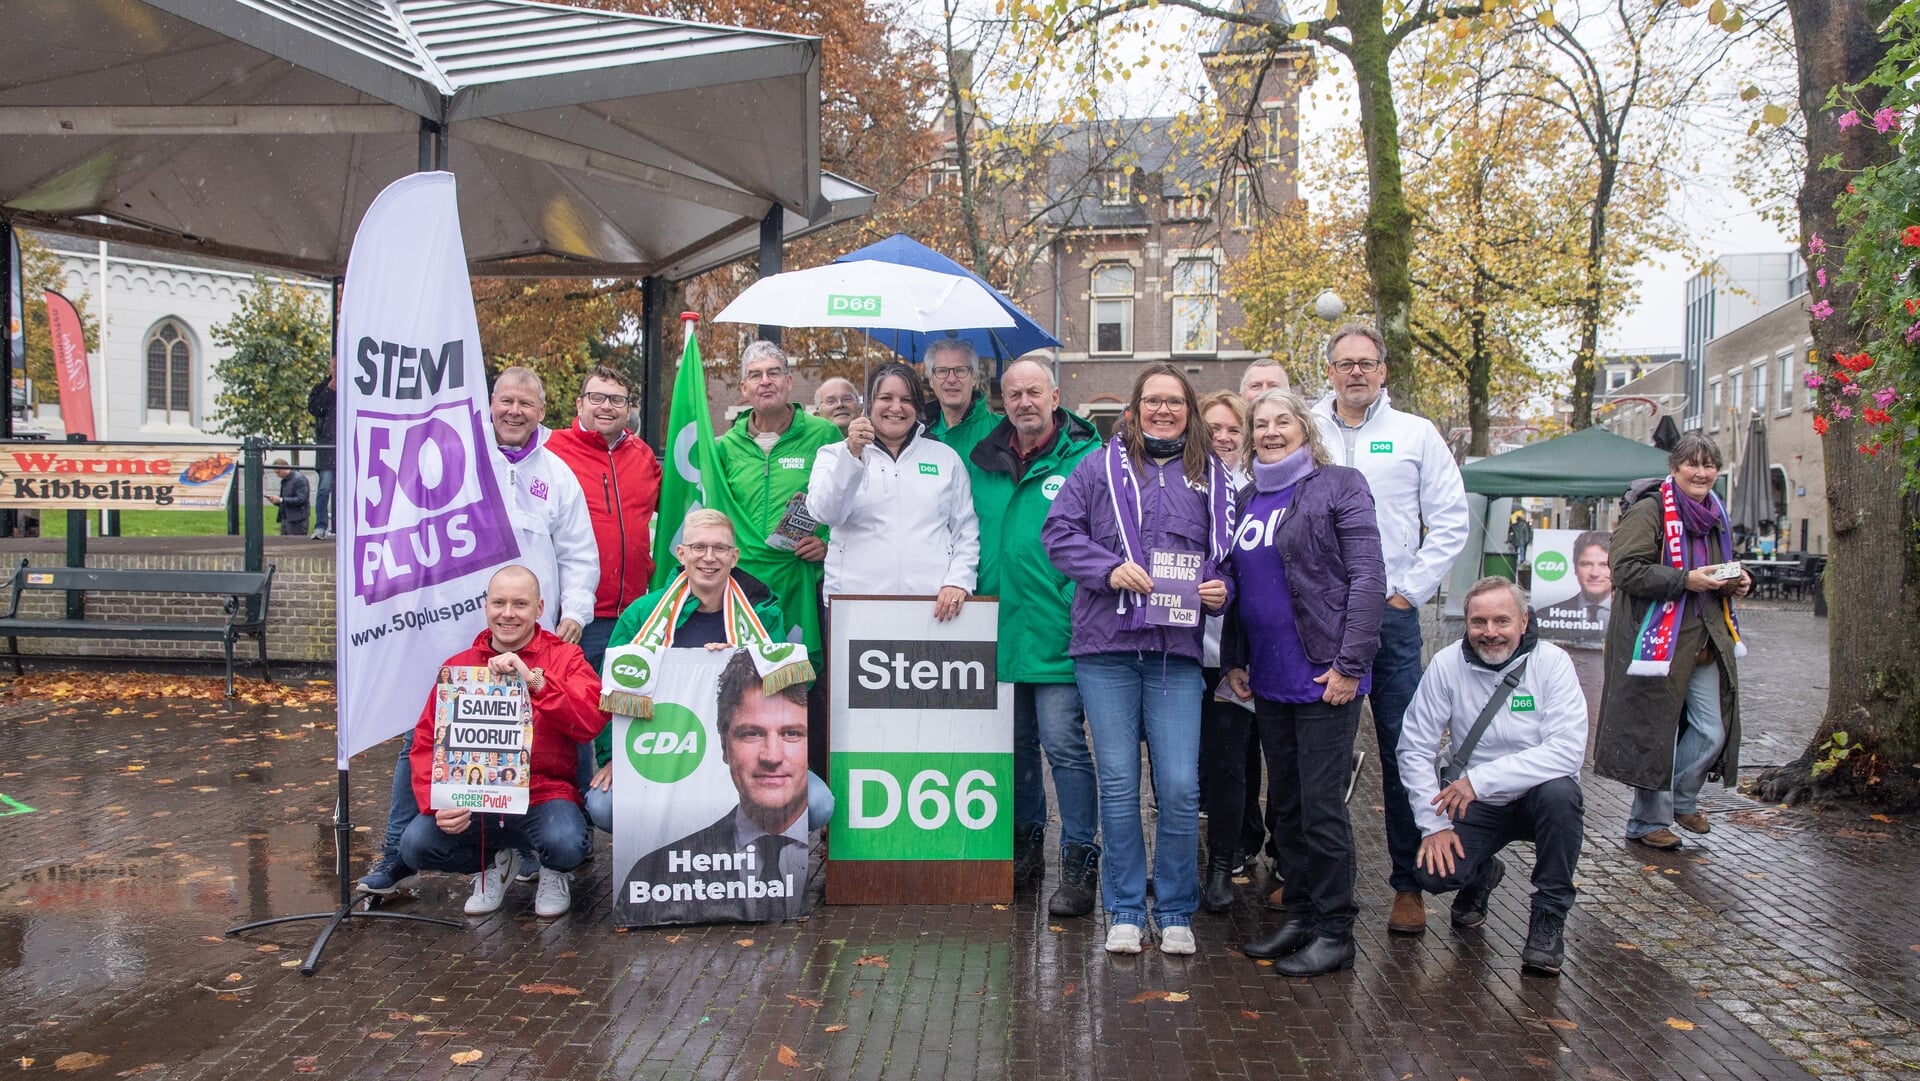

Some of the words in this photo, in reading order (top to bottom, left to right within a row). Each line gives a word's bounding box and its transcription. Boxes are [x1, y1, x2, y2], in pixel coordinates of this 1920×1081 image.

[833, 297, 876, 311] D66
[354, 336, 464, 400] STEM
[1372, 443, 1391, 451] D66
[12, 452, 172, 475] Warme
[920, 465, 937, 473] D66
[365, 418, 466, 528] 50
[14, 478, 175, 506] Kibbeling
[533, 479, 546, 492] 50
[1044, 483, 1060, 491] CD
[363, 514, 477, 586] PLUS
[1153, 551, 1175, 566] DOE
[1176, 553, 1201, 568] IETS
[1536, 561, 1565, 571] CDA
[1152, 565, 1196, 581] NIEUWS
[1150, 592, 1182, 608] STEM
[1173, 611, 1193, 621] Volt
[1549, 607, 1587, 618] Henri
[614, 664, 648, 680] CDA
[858, 649, 985, 690] Stem
[462, 699, 517, 716] SAMEN
[1513, 699, 1533, 708] D66
[455, 727, 521, 746] VOORUIT
[633, 731, 698, 755] CDA
[451, 793, 483, 801] GROEN
[456, 800, 483, 808] LINKS
[482, 794, 508, 809] PvdA
[849, 769, 998, 830] D66
[668, 844, 756, 873] Henri
[629, 873, 794, 904] Bontenbal
